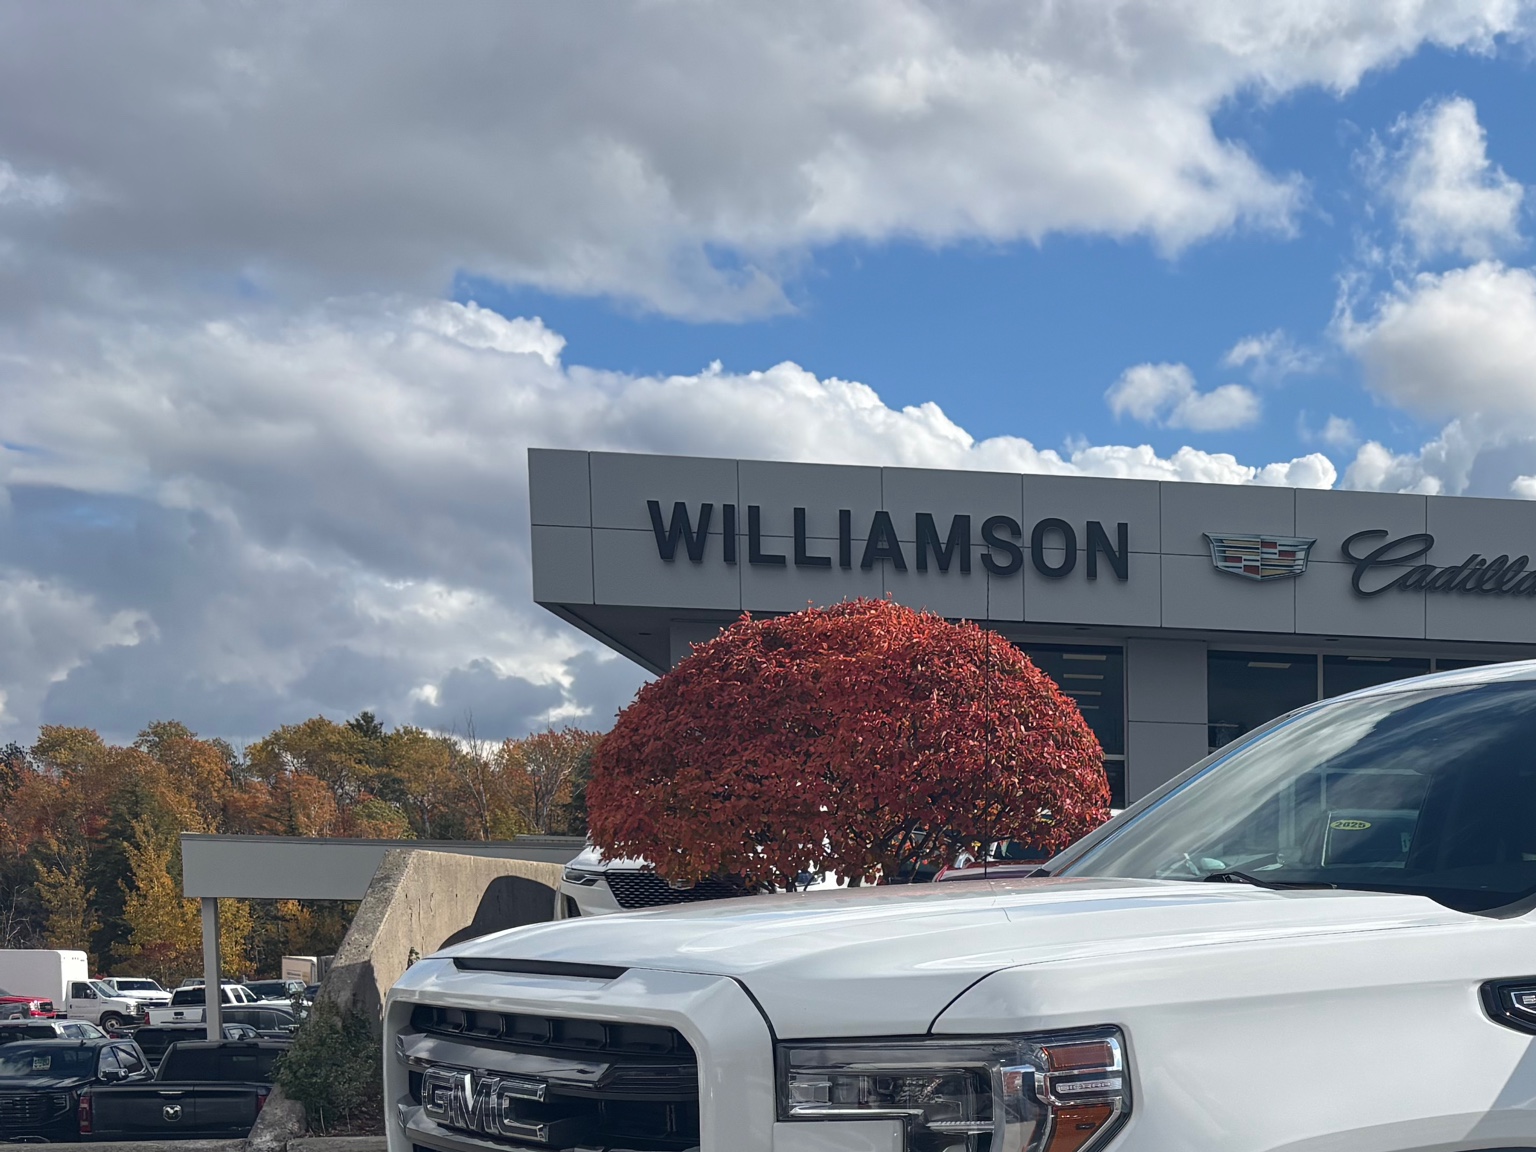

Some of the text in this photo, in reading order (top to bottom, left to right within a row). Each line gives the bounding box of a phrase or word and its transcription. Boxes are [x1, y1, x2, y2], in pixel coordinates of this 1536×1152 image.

[647, 500, 1128, 581] WILLIAMSON
[1334, 821, 1366, 829] 2025
[421, 1066, 549, 1142] GMC
